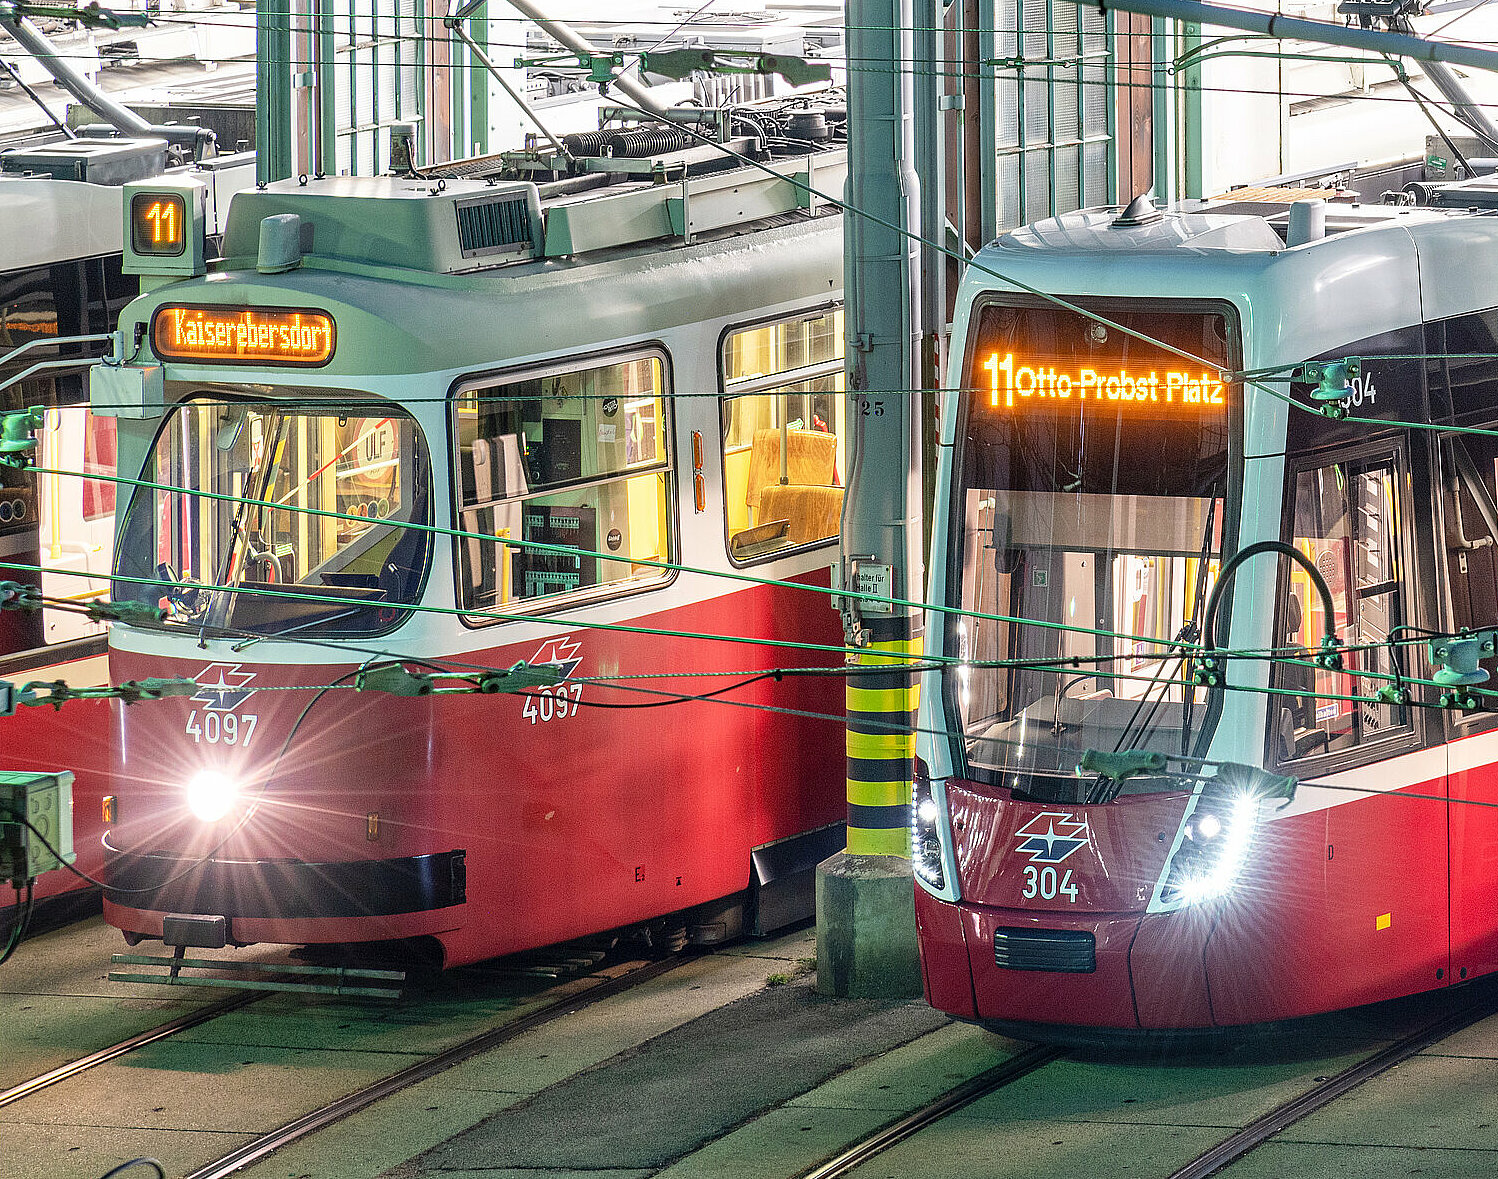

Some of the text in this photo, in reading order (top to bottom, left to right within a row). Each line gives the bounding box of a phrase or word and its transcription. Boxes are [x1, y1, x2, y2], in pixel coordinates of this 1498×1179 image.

[146, 202, 175, 242] 11
[983, 352, 1225, 406] 11 Otto-Probst-Platz
[861, 400, 885, 417] 25
[521, 683, 583, 725] 4097
[185, 710, 258, 747] 4097
[1022, 865, 1079, 903] 304
